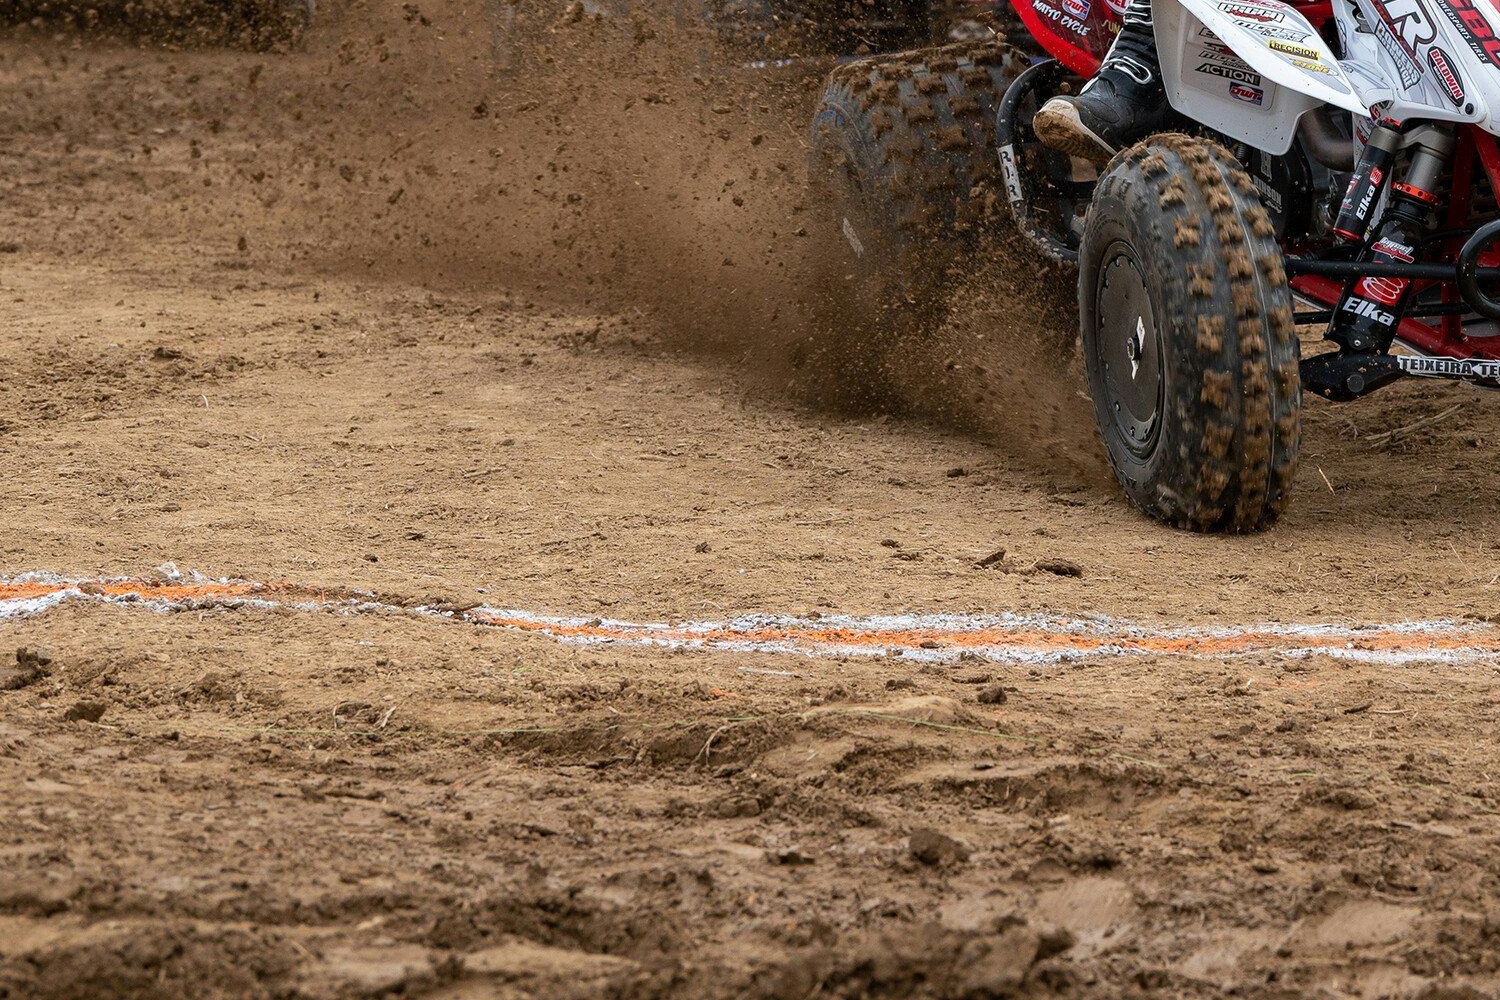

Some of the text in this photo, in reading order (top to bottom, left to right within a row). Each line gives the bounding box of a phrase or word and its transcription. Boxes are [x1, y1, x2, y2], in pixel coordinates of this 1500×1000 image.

[1032, 0, 1092, 37] MATTO CYCLE
[1471, 42, 1488, 62] TIRES
[1199, 64, 1255, 83] ACTION
[1429, 48, 1464, 100] BALDWIN
[1355, 184, 1376, 221] Elka
[1342, 296, 1396, 327] Elka
[1400, 357, 1474, 375] TEIXEIRA
